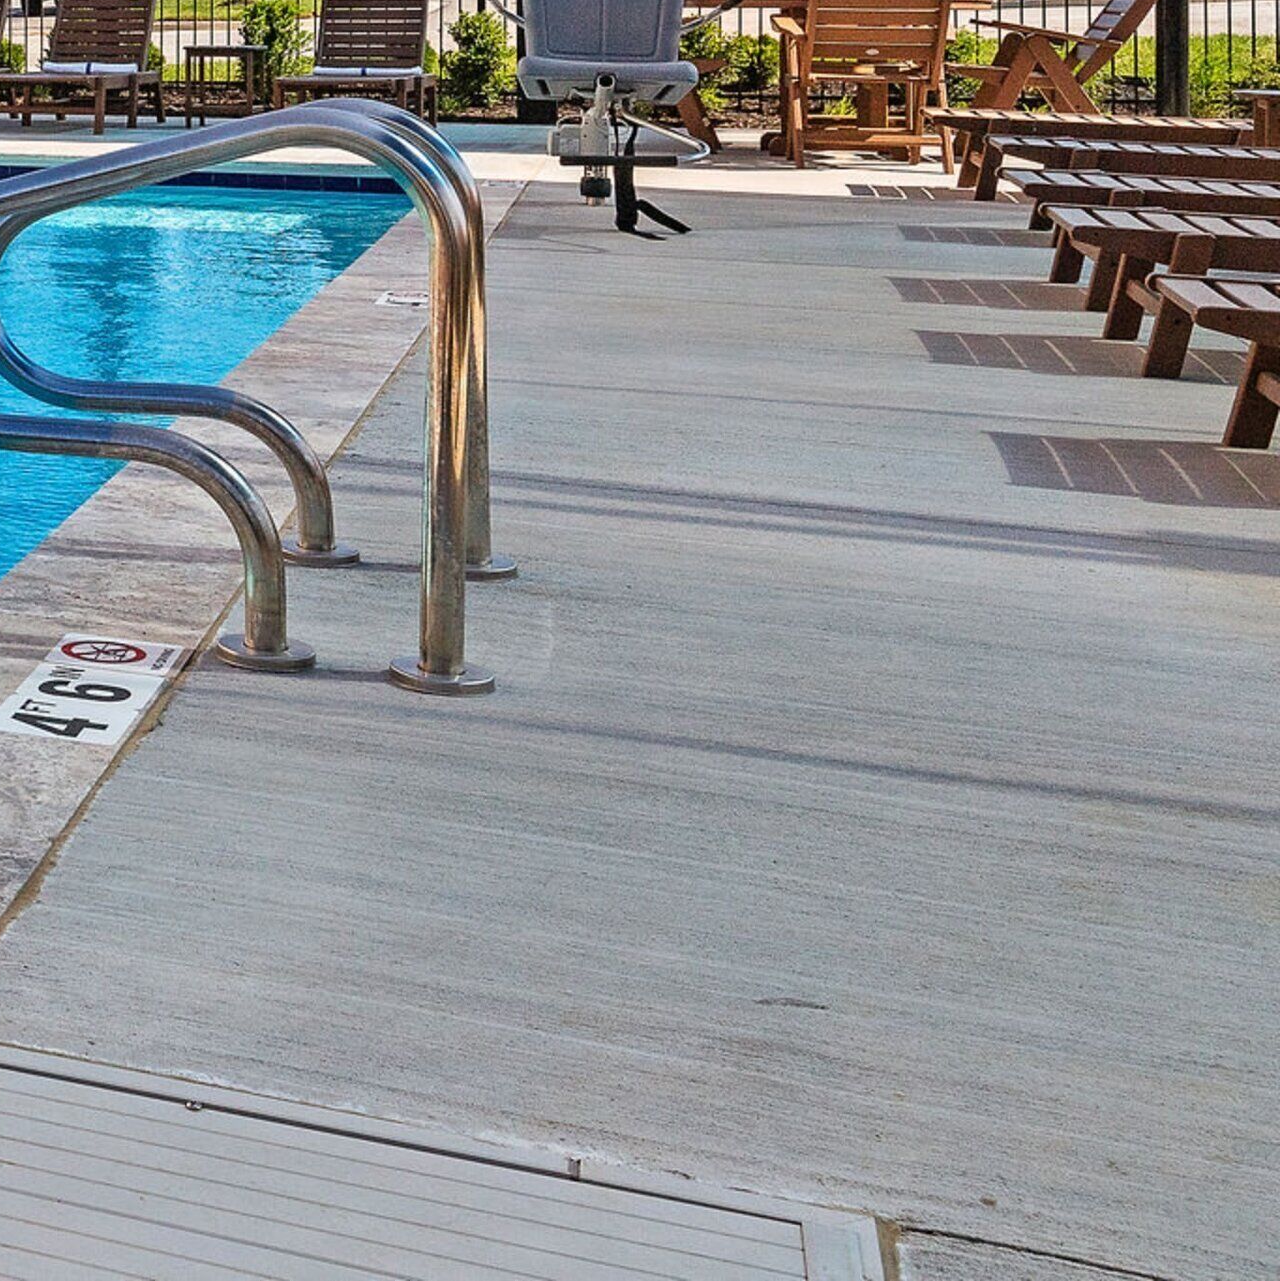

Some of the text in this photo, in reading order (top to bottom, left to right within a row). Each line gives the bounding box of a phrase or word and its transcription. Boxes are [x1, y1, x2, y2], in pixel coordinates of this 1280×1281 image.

[11, 665, 132, 738] 4 FT 6 IN
